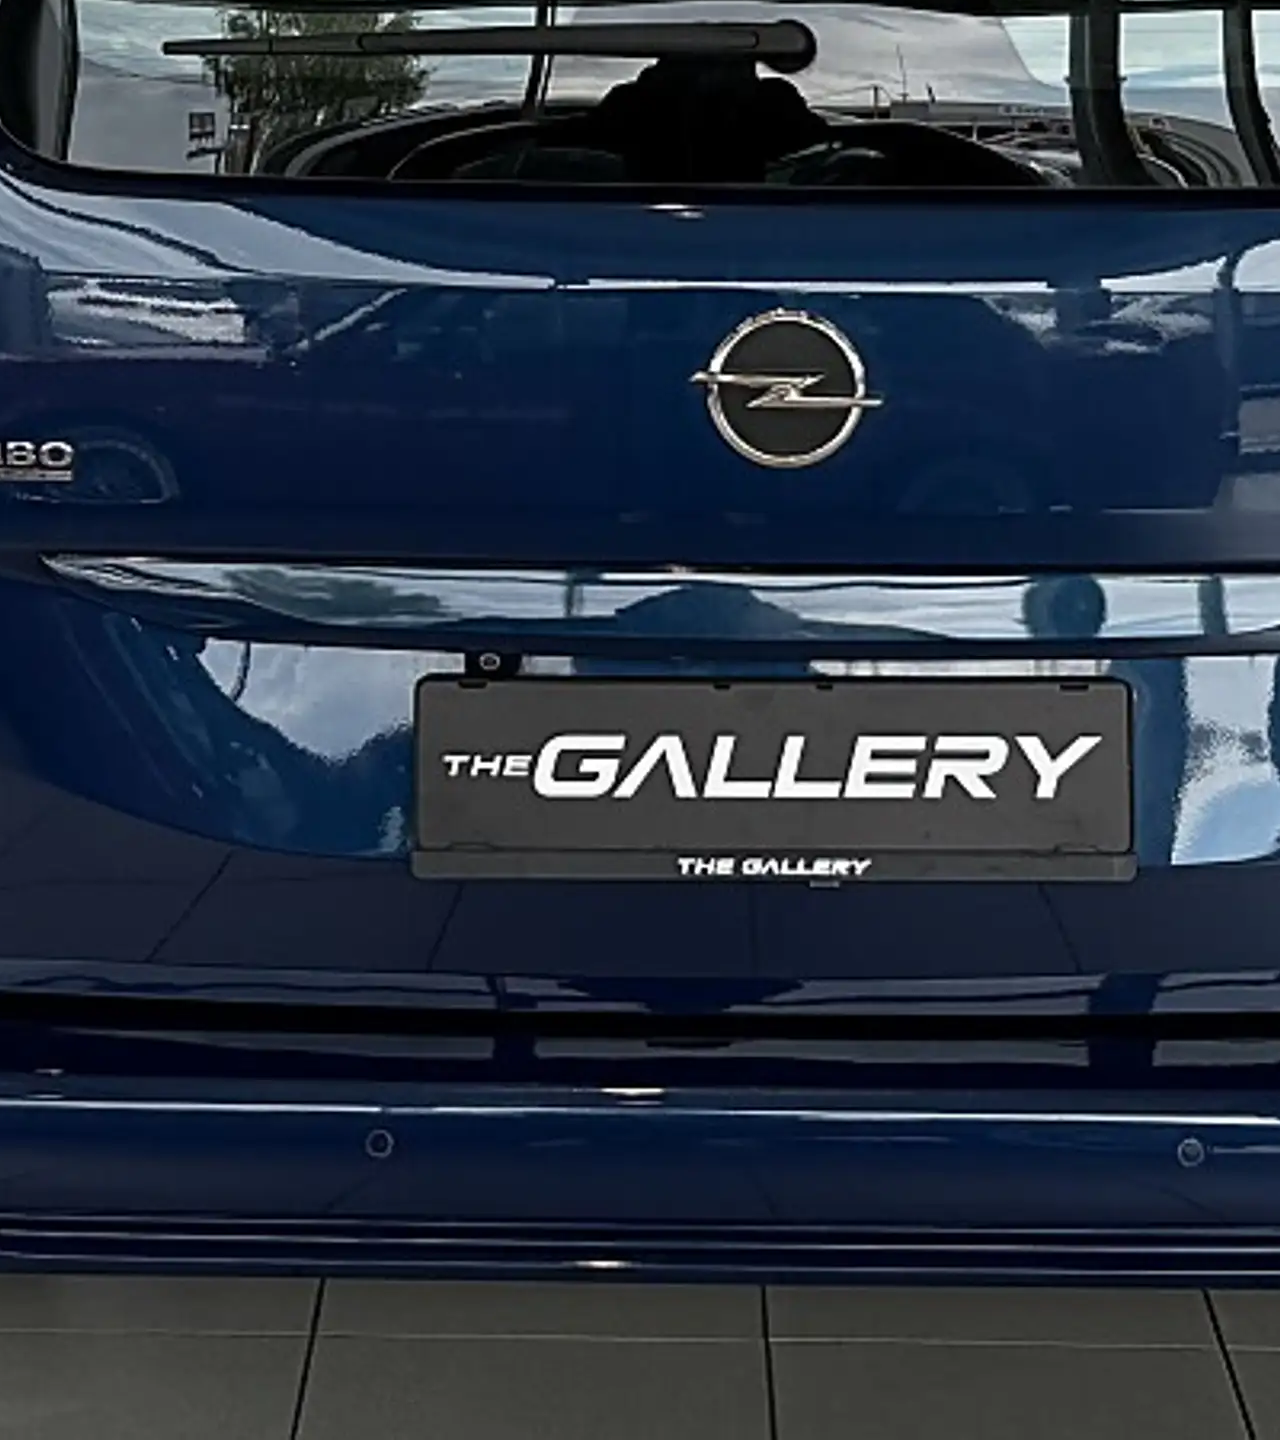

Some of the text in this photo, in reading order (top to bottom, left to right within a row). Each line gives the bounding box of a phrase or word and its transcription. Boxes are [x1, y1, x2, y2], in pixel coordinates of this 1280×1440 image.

[443, 735, 1102, 798] THE GALLERY
[677, 857, 872, 875] THE GALLERY
